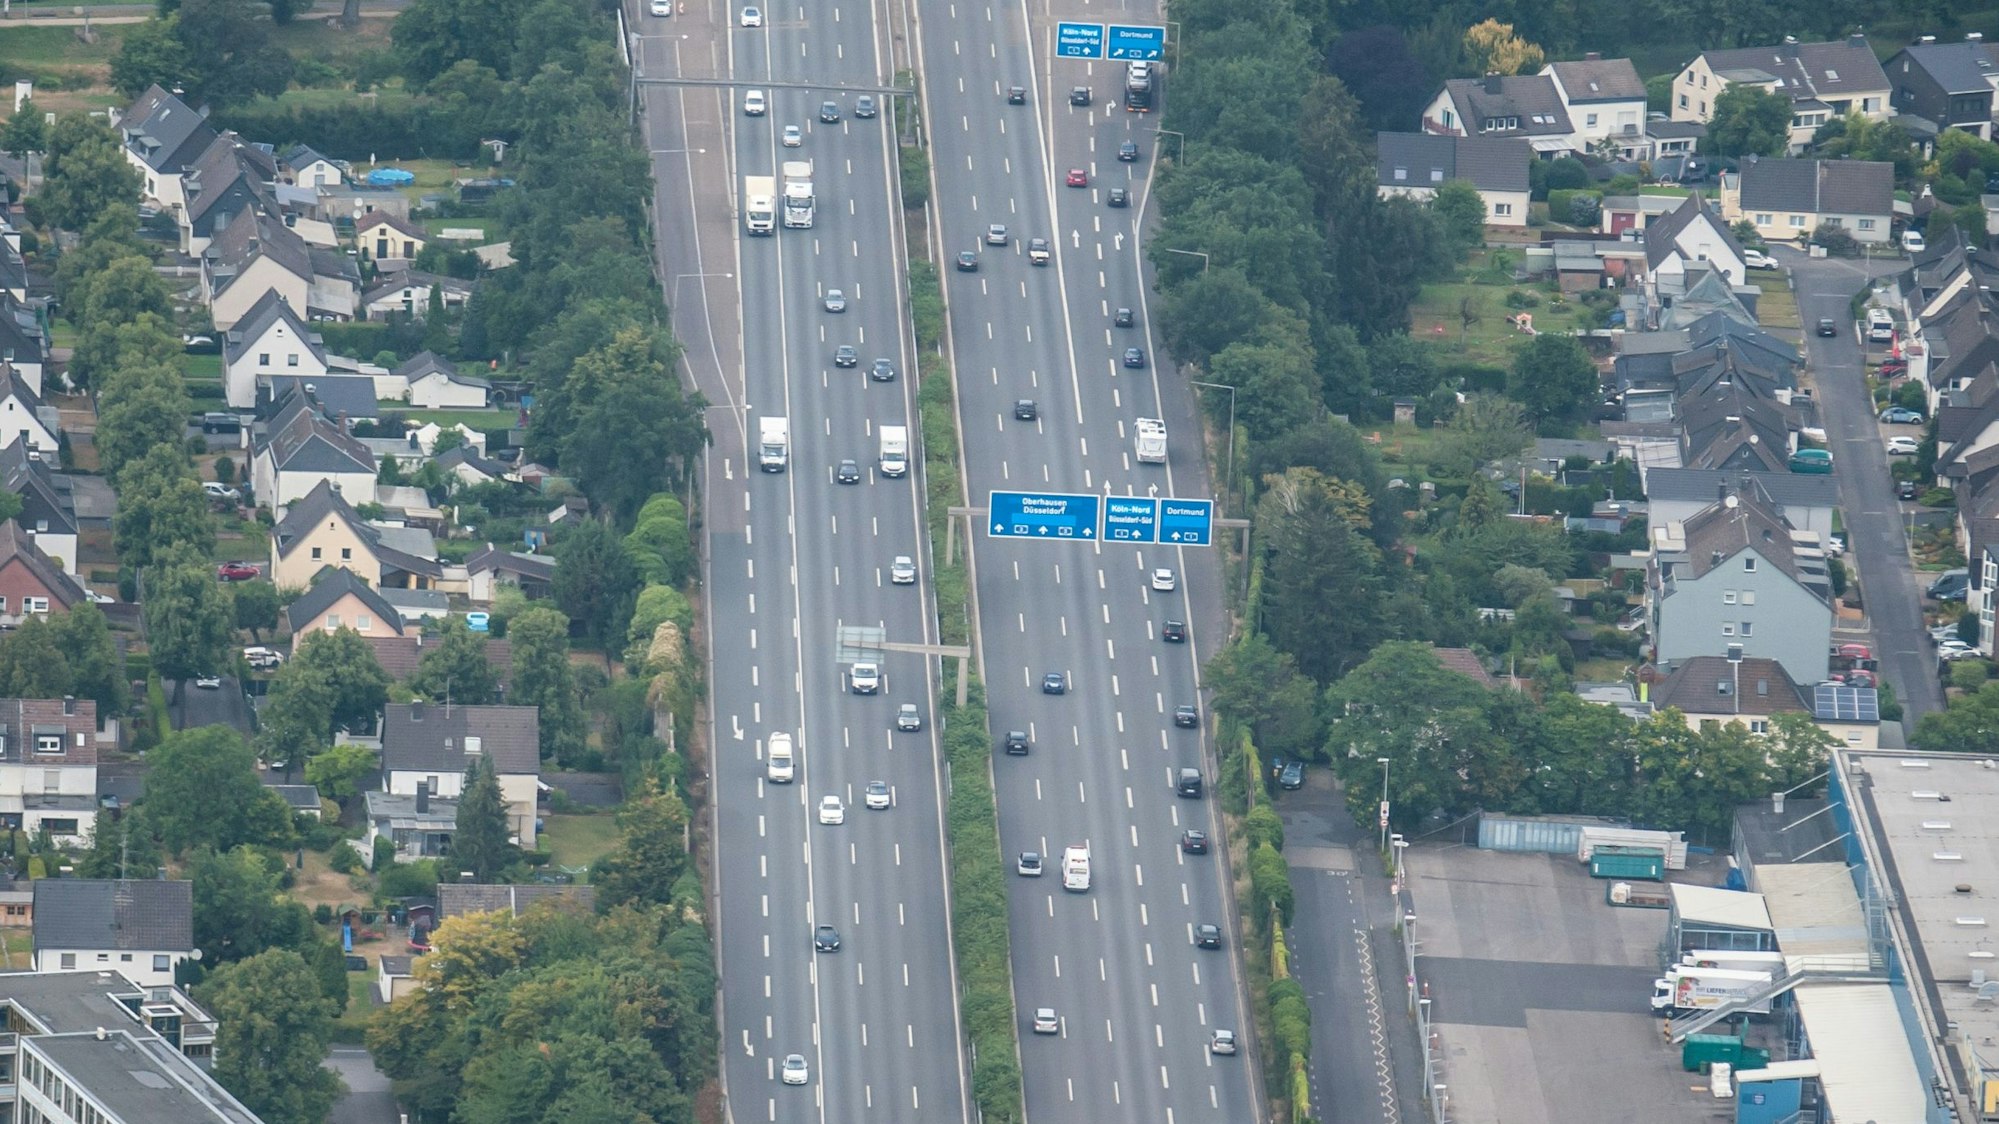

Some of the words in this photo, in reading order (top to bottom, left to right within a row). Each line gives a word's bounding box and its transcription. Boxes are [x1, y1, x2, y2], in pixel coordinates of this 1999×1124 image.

[1120, 31, 1153, 39] Dortmund
[1022, 498, 1067, 506] Oberhausen
[1023, 506, 1065, 514] Düsseldorf
[1111, 505, 1150, 514] Köln-Nord
[1167, 507, 1205, 516] Dortmund
[1109, 515, 1152, 524] Düsseldorf-Süd
